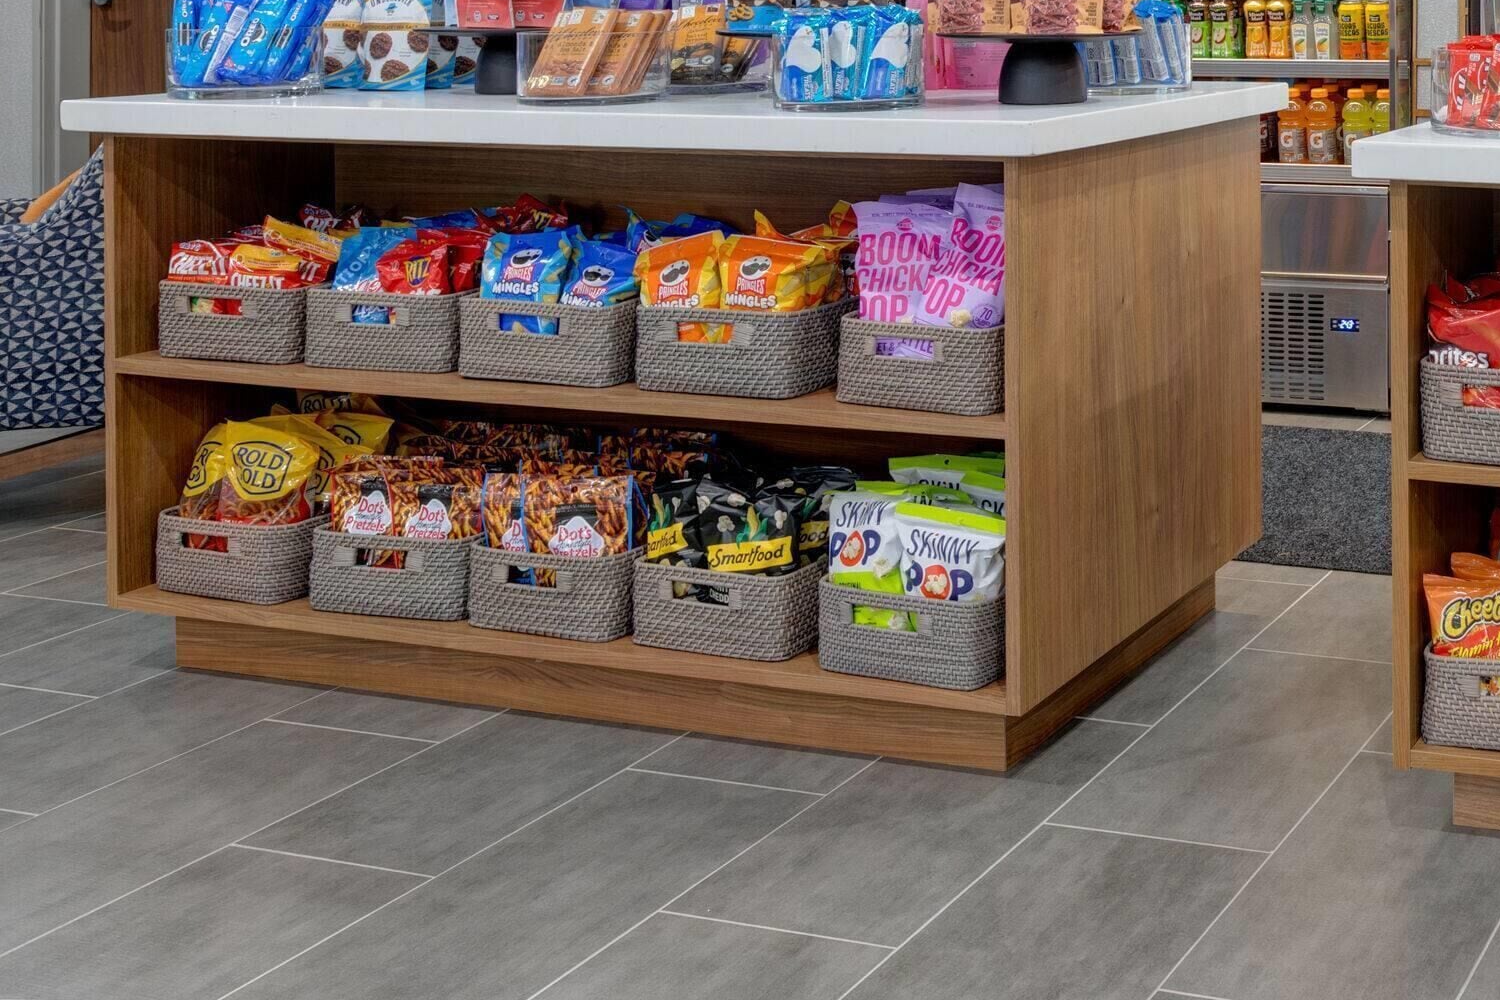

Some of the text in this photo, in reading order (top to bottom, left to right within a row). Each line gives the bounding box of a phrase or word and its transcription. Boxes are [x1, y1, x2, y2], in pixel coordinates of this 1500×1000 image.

[859, 231, 941, 267] BOOM
[404, 255, 432, 279] RITZ
[504, 265, 533, 282] PRINGLES
[658, 280, 688, 299] PRINGLES
[736, 276, 766, 296] PRINGLES
[980, 307, 992, 321] 70
[236, 446, 285, 472] ROLD
[358, 499, 385, 515] Dot's
[418, 506, 445, 523] Dot's
[344, 515, 386, 534] Pretzels
[407, 525, 446, 540] Pretzels
[557, 525, 592, 542] Dot's
[709, 544, 785, 567] Smartfood
[829, 529, 882, 567] POP
[905, 560, 974, 602] POP
